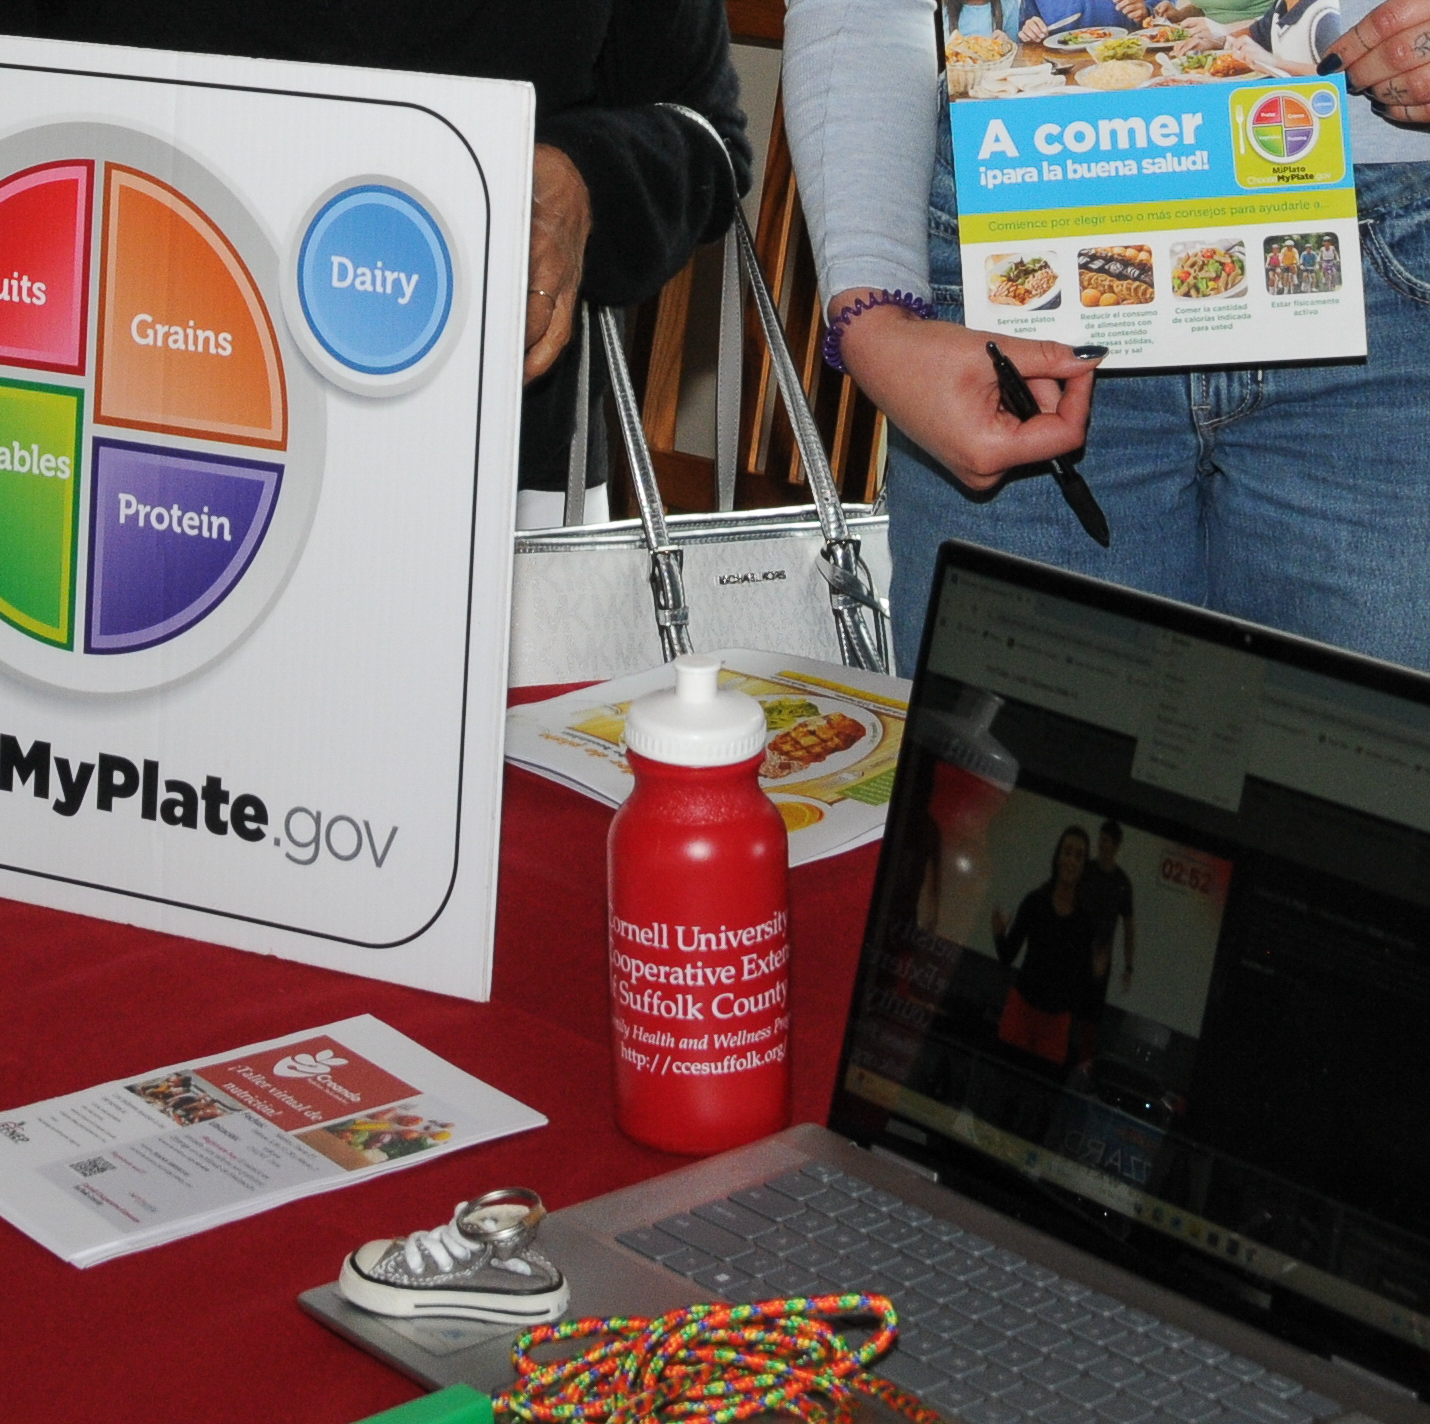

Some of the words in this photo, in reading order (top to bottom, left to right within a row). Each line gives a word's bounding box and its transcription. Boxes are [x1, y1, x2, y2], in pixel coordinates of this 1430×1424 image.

[977, 118, 1020, 160] A
[1033, 112, 1203, 156] comer
[979, 166, 1039, 189] ¡para
[1042, 161, 1063, 182] la
[1066, 158, 1138, 180] buena
[1141, 150, 1210, 175] salud!
[988, 219, 1048, 232] Comience
[1051, 217, 1070, 229] por
[1074, 214, 1107, 227] elegir
[1111, 212, 1133, 223] uno
[1148, 209, 1171, 221] más
[1175, 206, 1227, 220] consejos
[1230, 204, 1256, 217] para
[1259, 199, 1310, 216] ayudarle
[329, 255, 420, 307] Dairy
[129, 311, 234, 359] Grains
[117, 491, 232, 543] Protein
[675, 909, 788, 952] University
[741, 943, 790, 981] Exten
[619, 980, 704, 1020] Suffolk
[712, 978, 788, 1019] County
[632, 1024, 675, 1049] Health
[679, 1034, 709, 1051] and
[713, 1025, 771, 1050] Wellness
